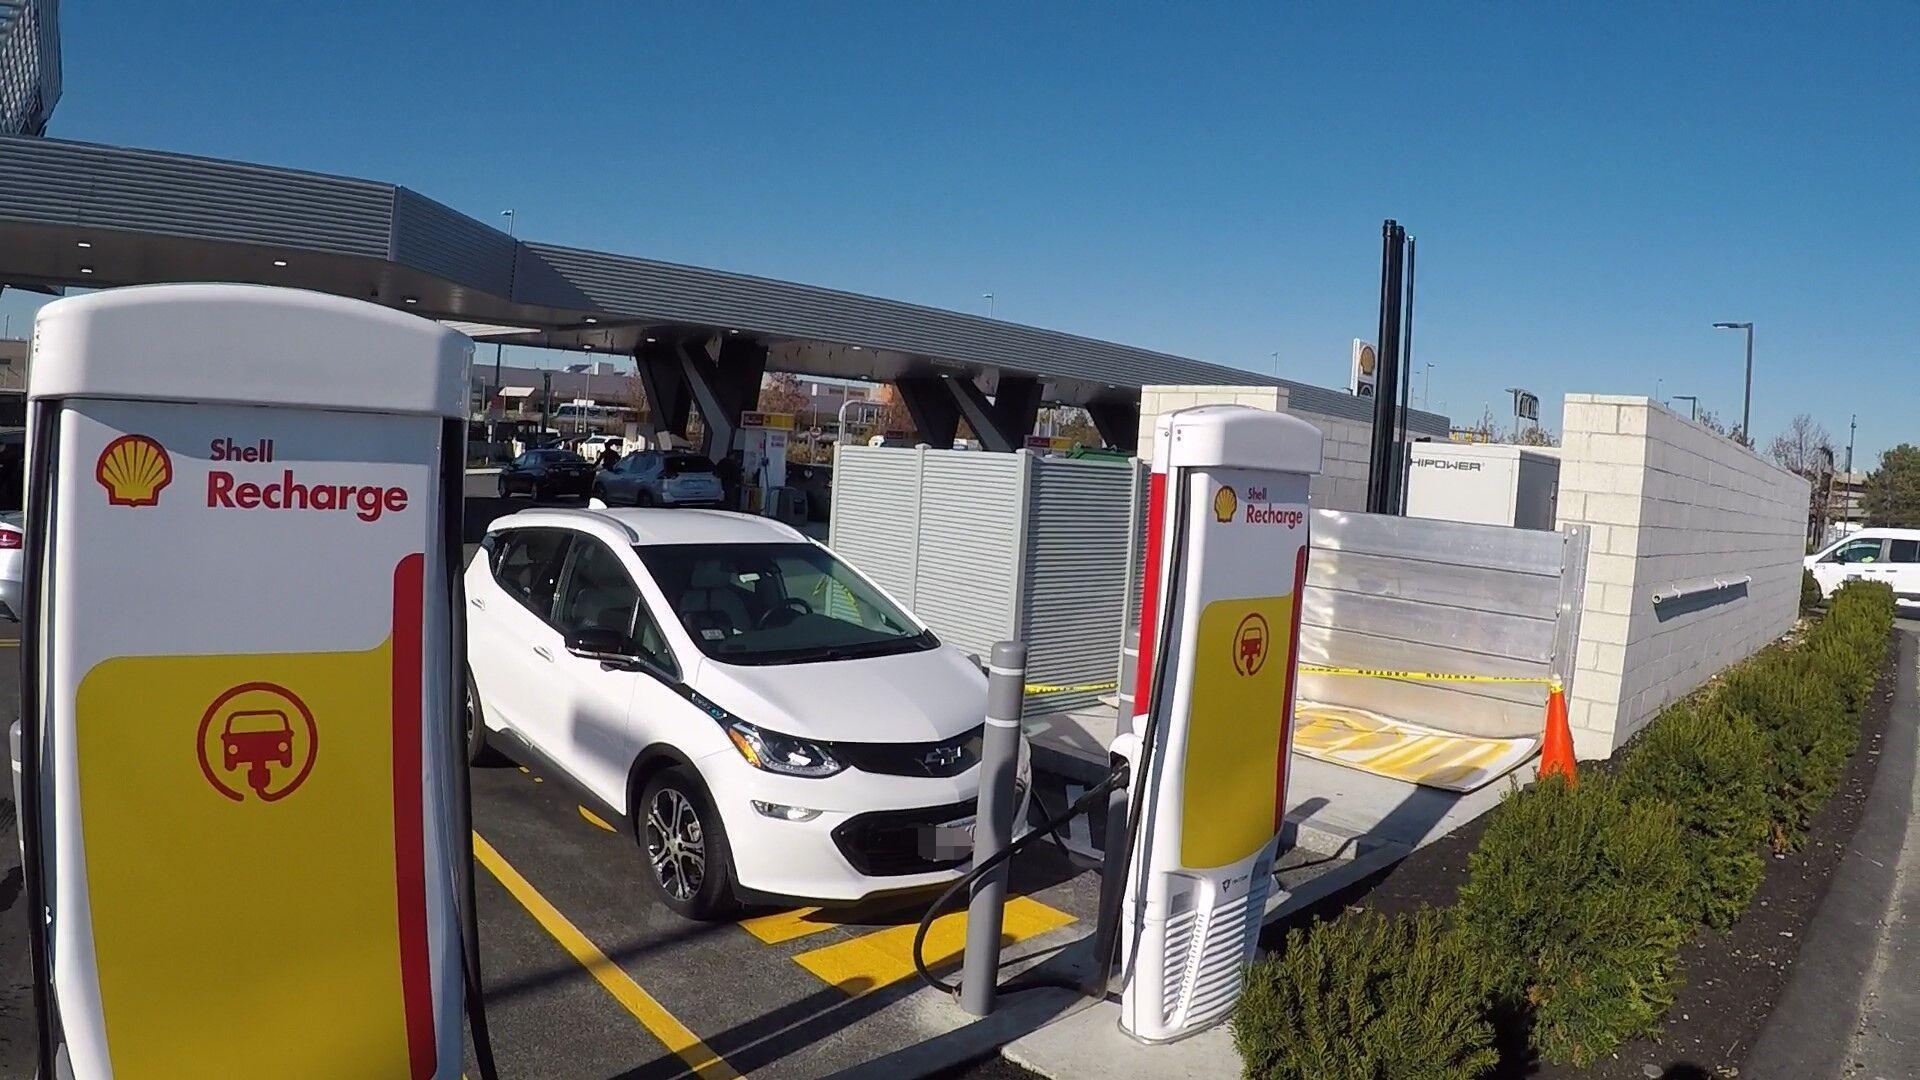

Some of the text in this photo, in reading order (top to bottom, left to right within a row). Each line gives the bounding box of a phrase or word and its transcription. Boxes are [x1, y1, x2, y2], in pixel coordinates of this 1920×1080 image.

[209, 437, 274, 463] Shell
[207, 469, 409, 522] Recharge
[1247, 486, 1267, 500] Shell
[1246, 502, 1303, 530] Recharge
